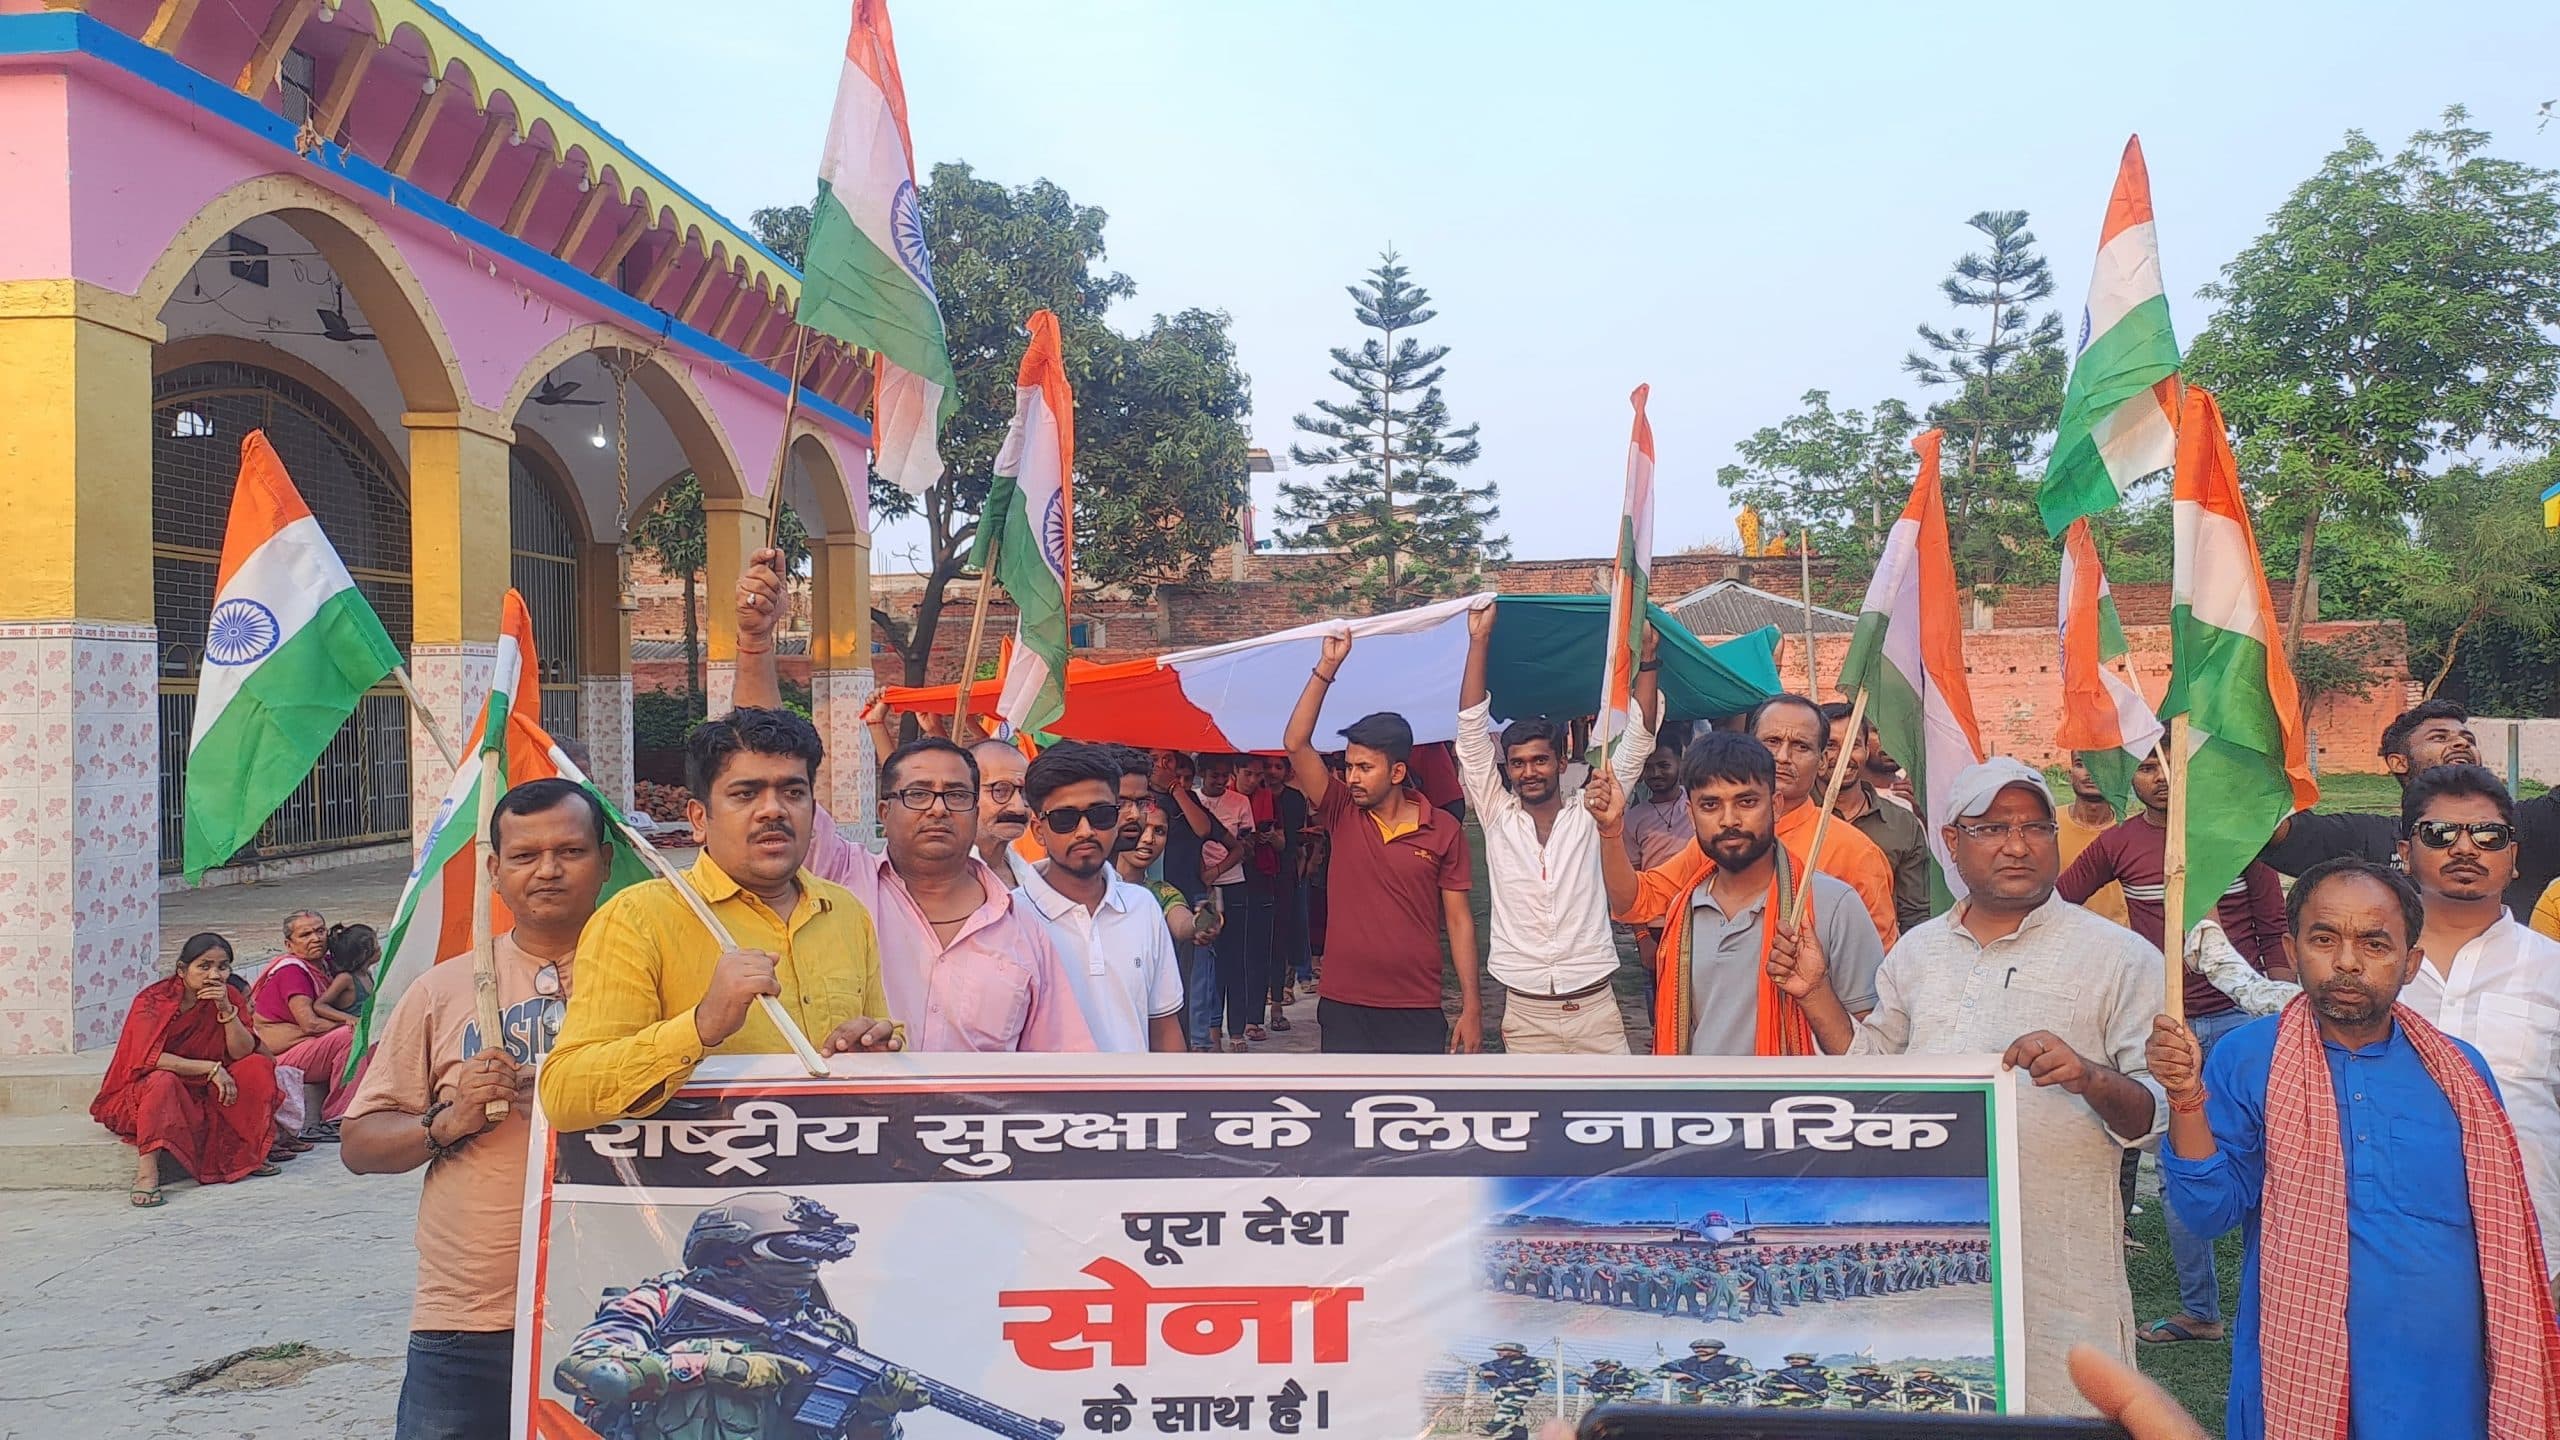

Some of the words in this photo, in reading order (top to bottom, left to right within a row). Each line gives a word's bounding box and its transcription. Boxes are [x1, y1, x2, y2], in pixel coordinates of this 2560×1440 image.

[585, 1101, 889, 1177] राष्ट्रीय
[914, 1110, 1187, 1176] सुरक्षा
[1211, 1096, 1320, 1150] के
[1346, 1095, 1539, 1152] लिए
[1563, 1095, 1958, 1151] नागरिक
[1121, 1211, 1227, 1266] पूरा
[1242, 1196, 1350, 1246] देश
[998, 1256, 1364, 1372] सेना
[1081, 1382, 1138, 1434] के
[1151, 1395, 1255, 1434] साथ
